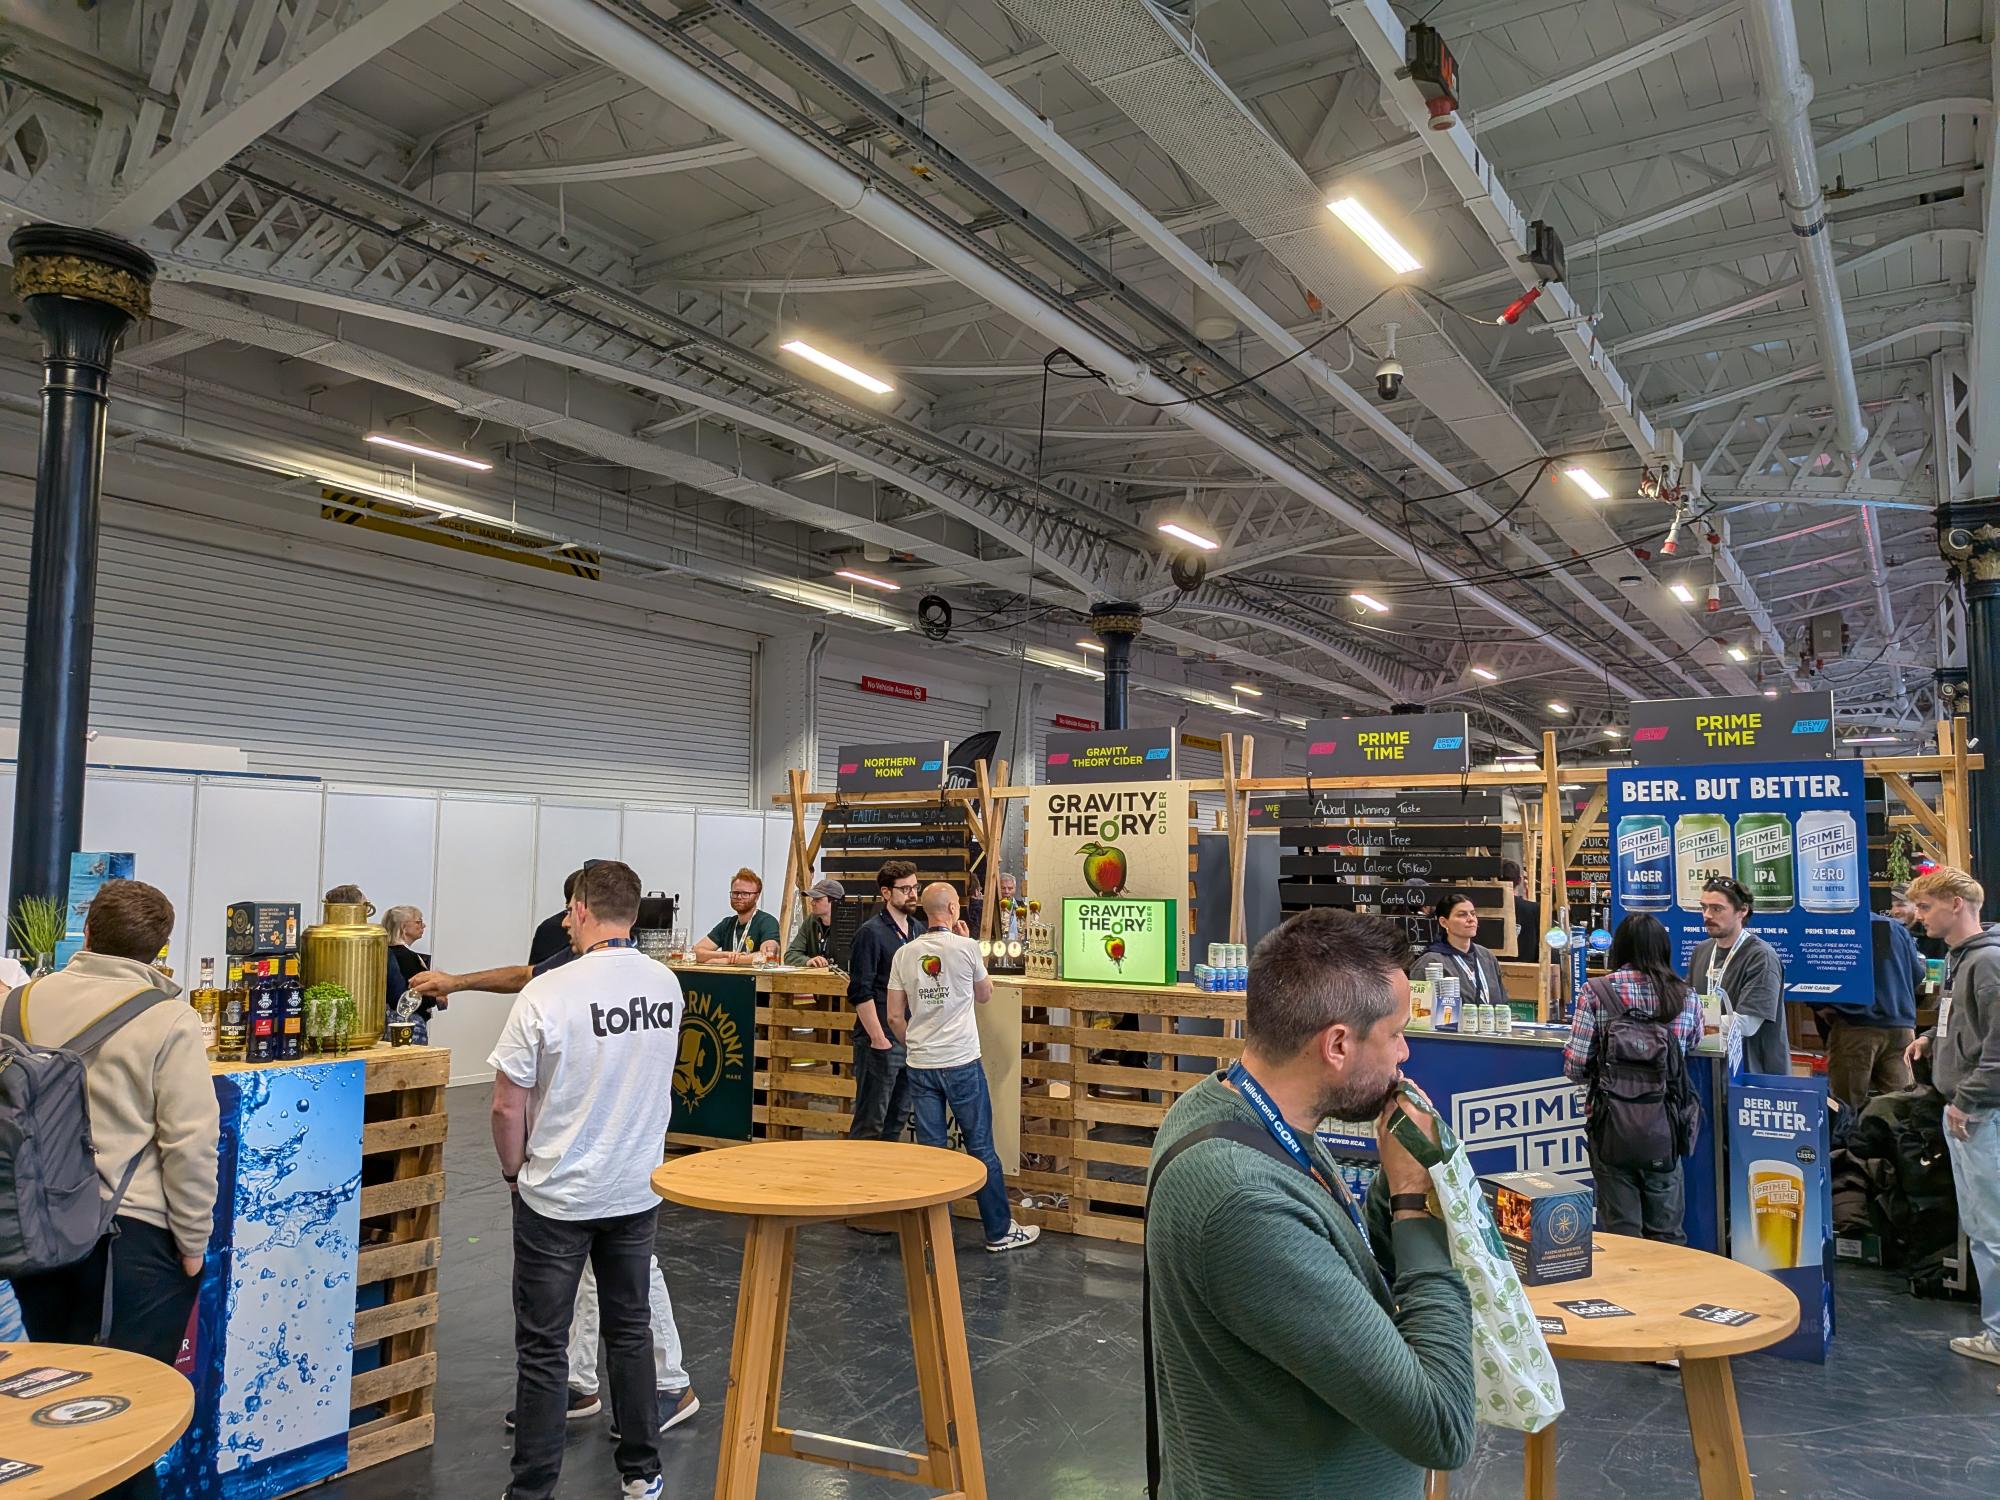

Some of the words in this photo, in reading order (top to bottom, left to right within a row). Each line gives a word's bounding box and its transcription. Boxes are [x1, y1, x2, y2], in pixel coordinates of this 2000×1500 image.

[867, 680, 876, 688] No
[1696, 713, 1762, 731] PRIME
[1358, 731, 1410, 747] PRIME
[1704, 730, 1755, 747] TIME
[1086, 746, 1128, 757] GRAVITY
[1363, 746, 1405, 761] TIME
[864, 757, 916, 768] NORTHERN
[1072, 757, 1110, 768] THEORY
[1113, 756, 1143, 766] CIDER
[875, 768, 904, 778] MONK
[1622, 780, 1686, 802] BEER.
[1695, 778, 1741, 800] BUT
[1750, 775, 1849, 799] BETTER.
[1048, 791, 1158, 814] GRAVITY
[1314, 800, 1346, 816] Award
[1354, 803, 1390, 817] Winning
[1396, 801, 1421, 814] Taste
[852, 809, 881, 823] FAITH
[1158, 791, 1167, 835] CIDER
[1048, 813, 1157, 842] THEORY
[1347, 828, 1385, 846] Gluten
[1389, 828, 1411, 846] Free
[1621, 831, 1658, 850] PRIME
[1679, 832, 1717, 851] PRIME
[1739, 829, 1778, 849] PRIME
[1801, 828, 1842, 849] PRIME
[1639, 841, 1668, 857] TIME
[1698, 844, 1727, 859] TIME
[1759, 841, 1788, 857] TIME
[1821, 840, 1853, 856] TIME
[1333, 858, 1357, 873] Low
[1363, 857, 1393, 873] Calorie
[1627, 870, 1663, 883] LAGER
[1688, 869, 1720, 881] PEAR
[1754, 870, 1776, 883] IPA
[1812, 868, 1844, 881] ZERO
[1351, 887, 1372, 904] Low
[1078, 904, 1146, 918] GRAVITY
[1078, 917, 1146, 935] THEORY
[918, 986, 950, 994] GRAVITY
[918, 992, 950, 1000] THEORY
[589, 996, 674, 1037] tofka
[709, 1003, 744, 1068] MONK
[1743, 1097, 1775, 1111] BEER.
[1776, 1100, 1798, 1112] BUT
[1241, 1078, 1278, 1122] Hillebrand
[1273, 1120, 1301, 1153] GORI
[1738, 1108, 1812, 1132] BETTER.
[1797, 1151, 1816, 1160] taste
[1757, 1183, 1788, 1194] PRIME
[1772, 1193, 1796, 1201] TIME
